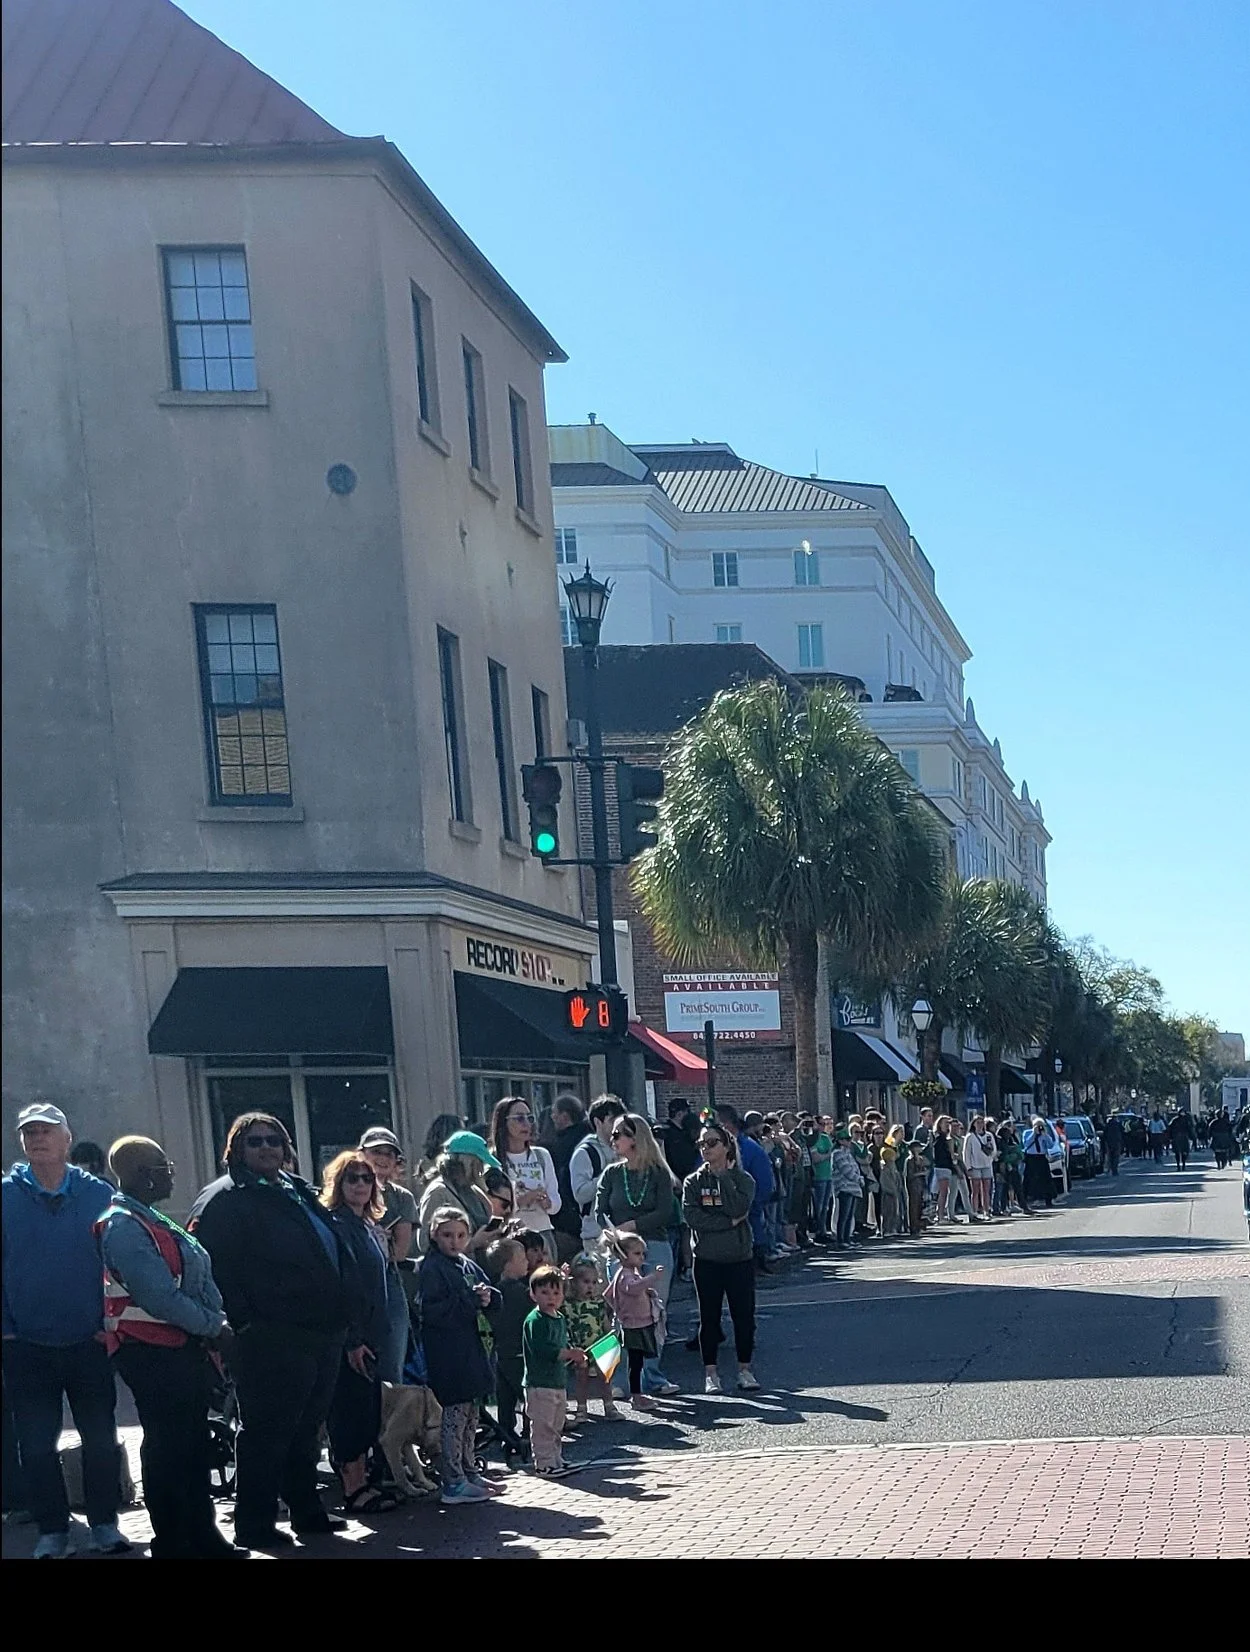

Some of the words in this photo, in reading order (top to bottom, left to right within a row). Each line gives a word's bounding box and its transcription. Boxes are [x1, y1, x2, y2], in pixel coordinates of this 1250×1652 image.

[729, 972, 777, 980] AVAILABLE
[673, 983, 769, 991] AVAILABLE
[732, 1001, 760, 1013] GROUP
[693, 1031, 756, 1039] 84722.4450
